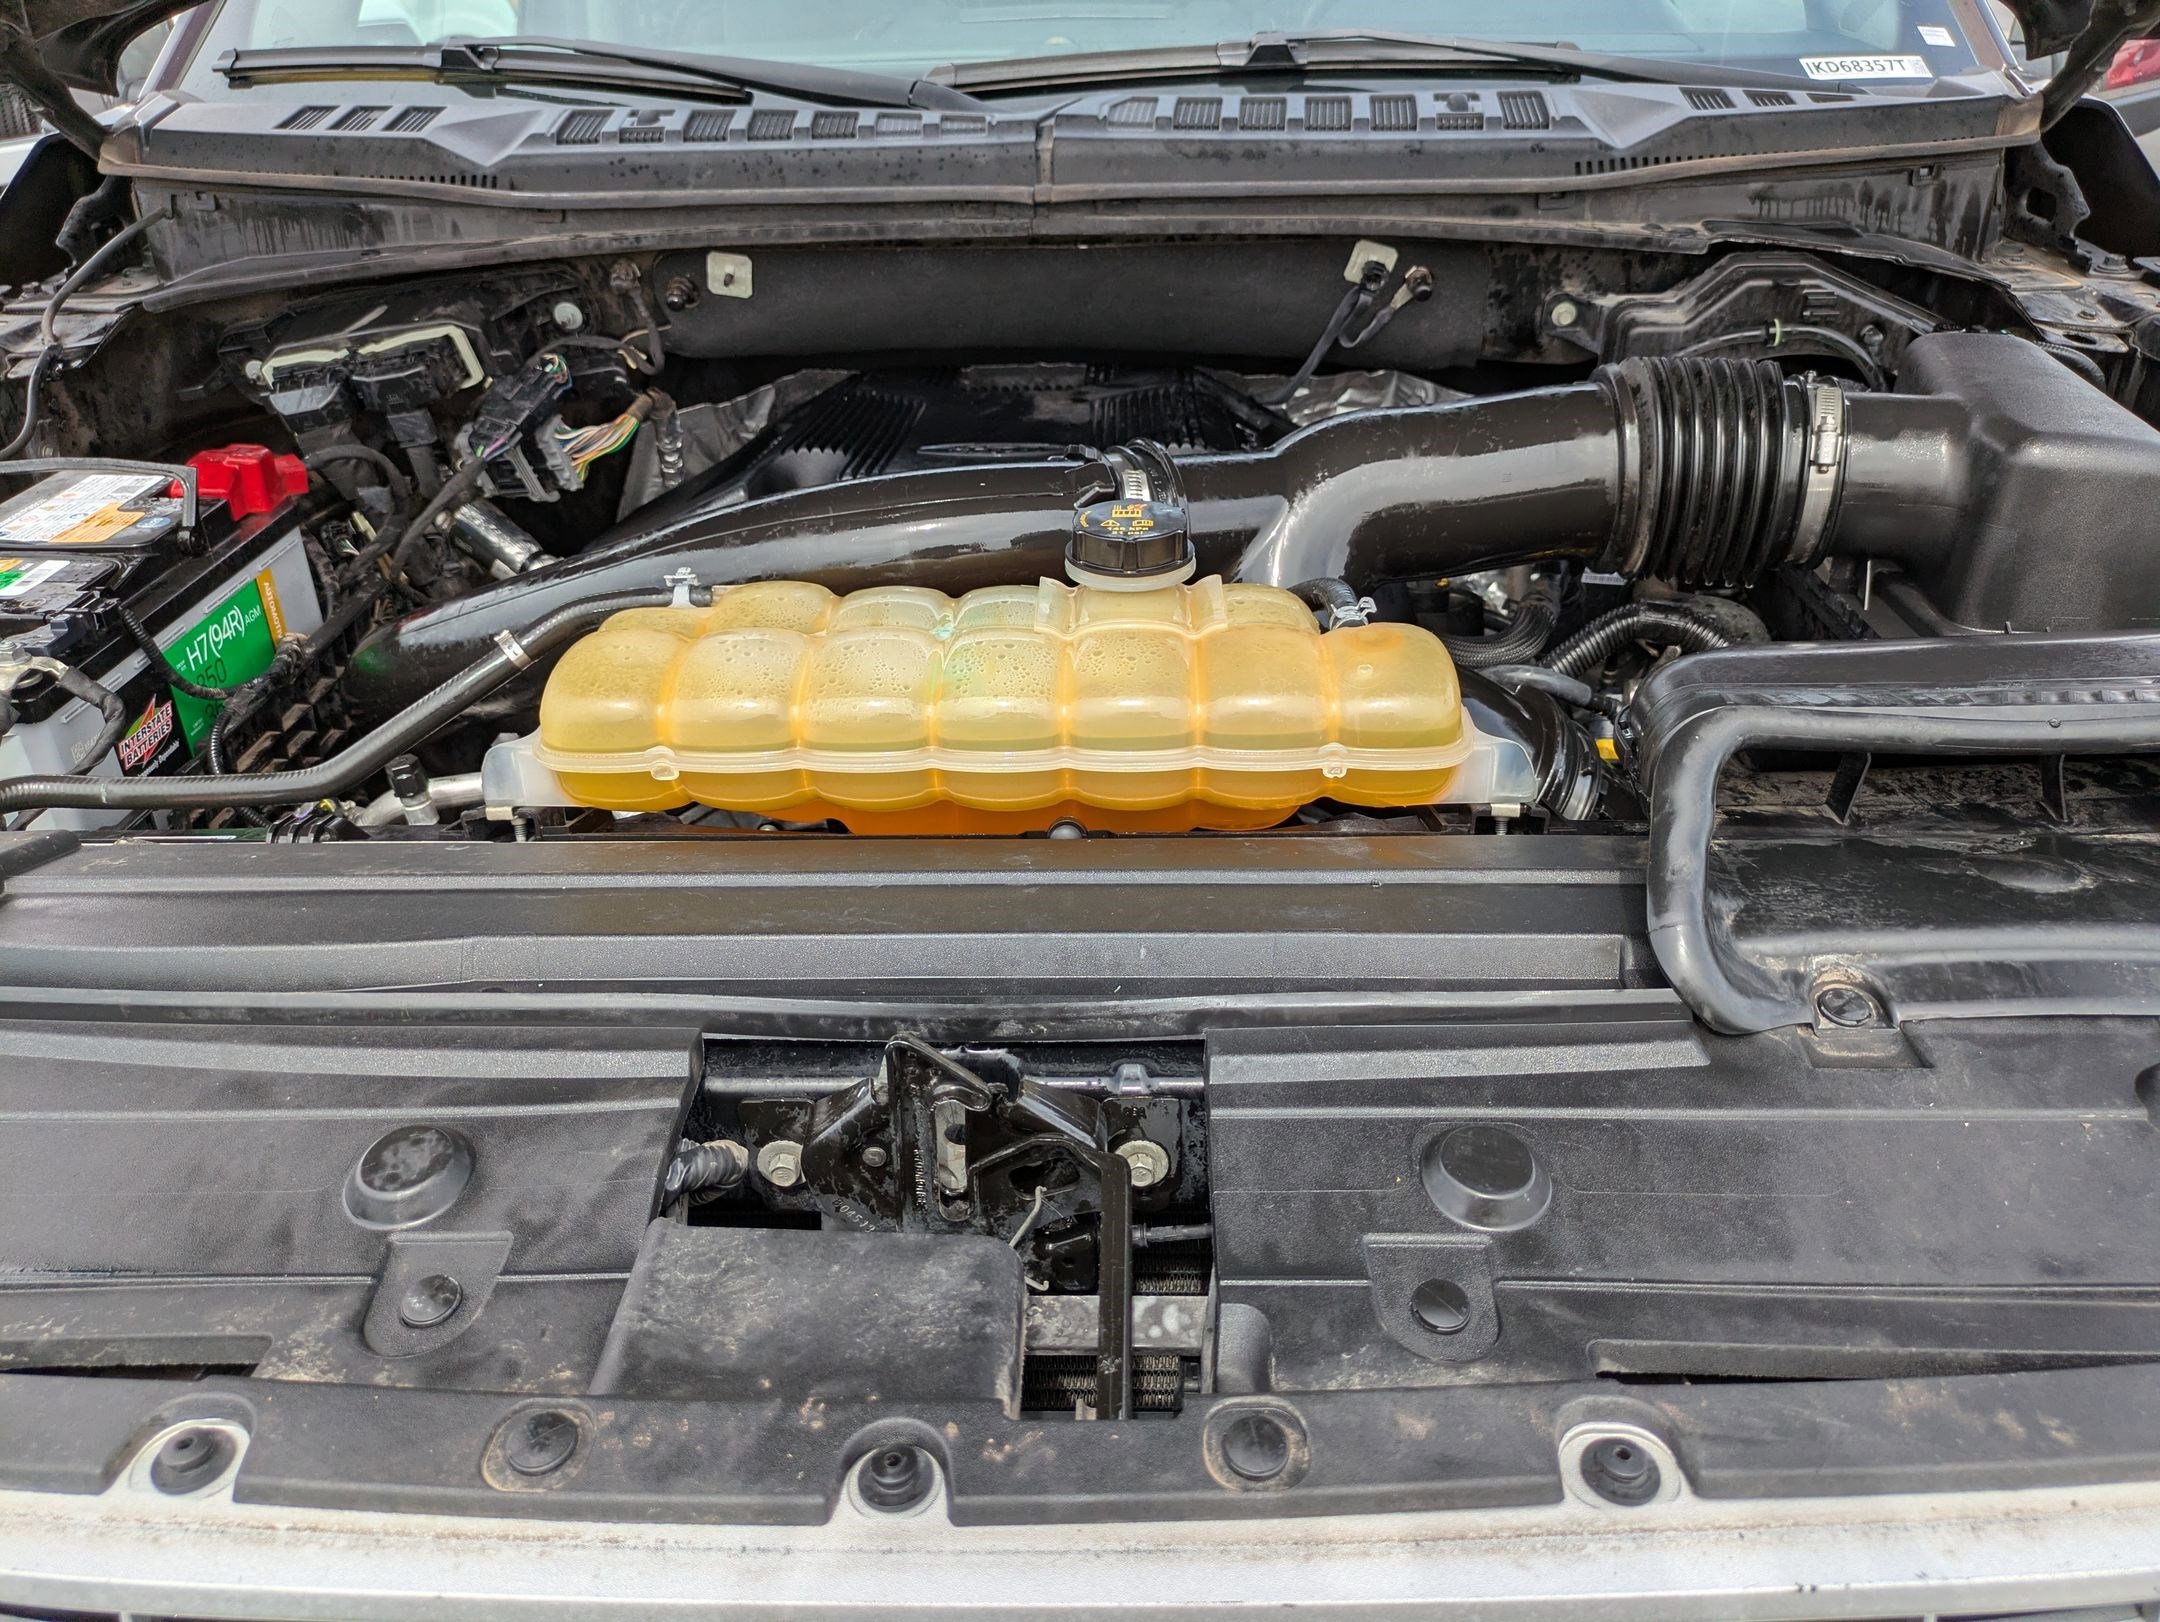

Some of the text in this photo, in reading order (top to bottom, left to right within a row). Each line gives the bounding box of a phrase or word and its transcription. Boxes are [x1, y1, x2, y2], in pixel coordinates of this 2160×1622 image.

[264, 582, 283, 639] AUTOMOTIV
[185, 605, 262, 672] H7(94R) AGM
[121, 704, 172, 755] INTERSTATE
[126, 720, 171, 766] BATTERIES
